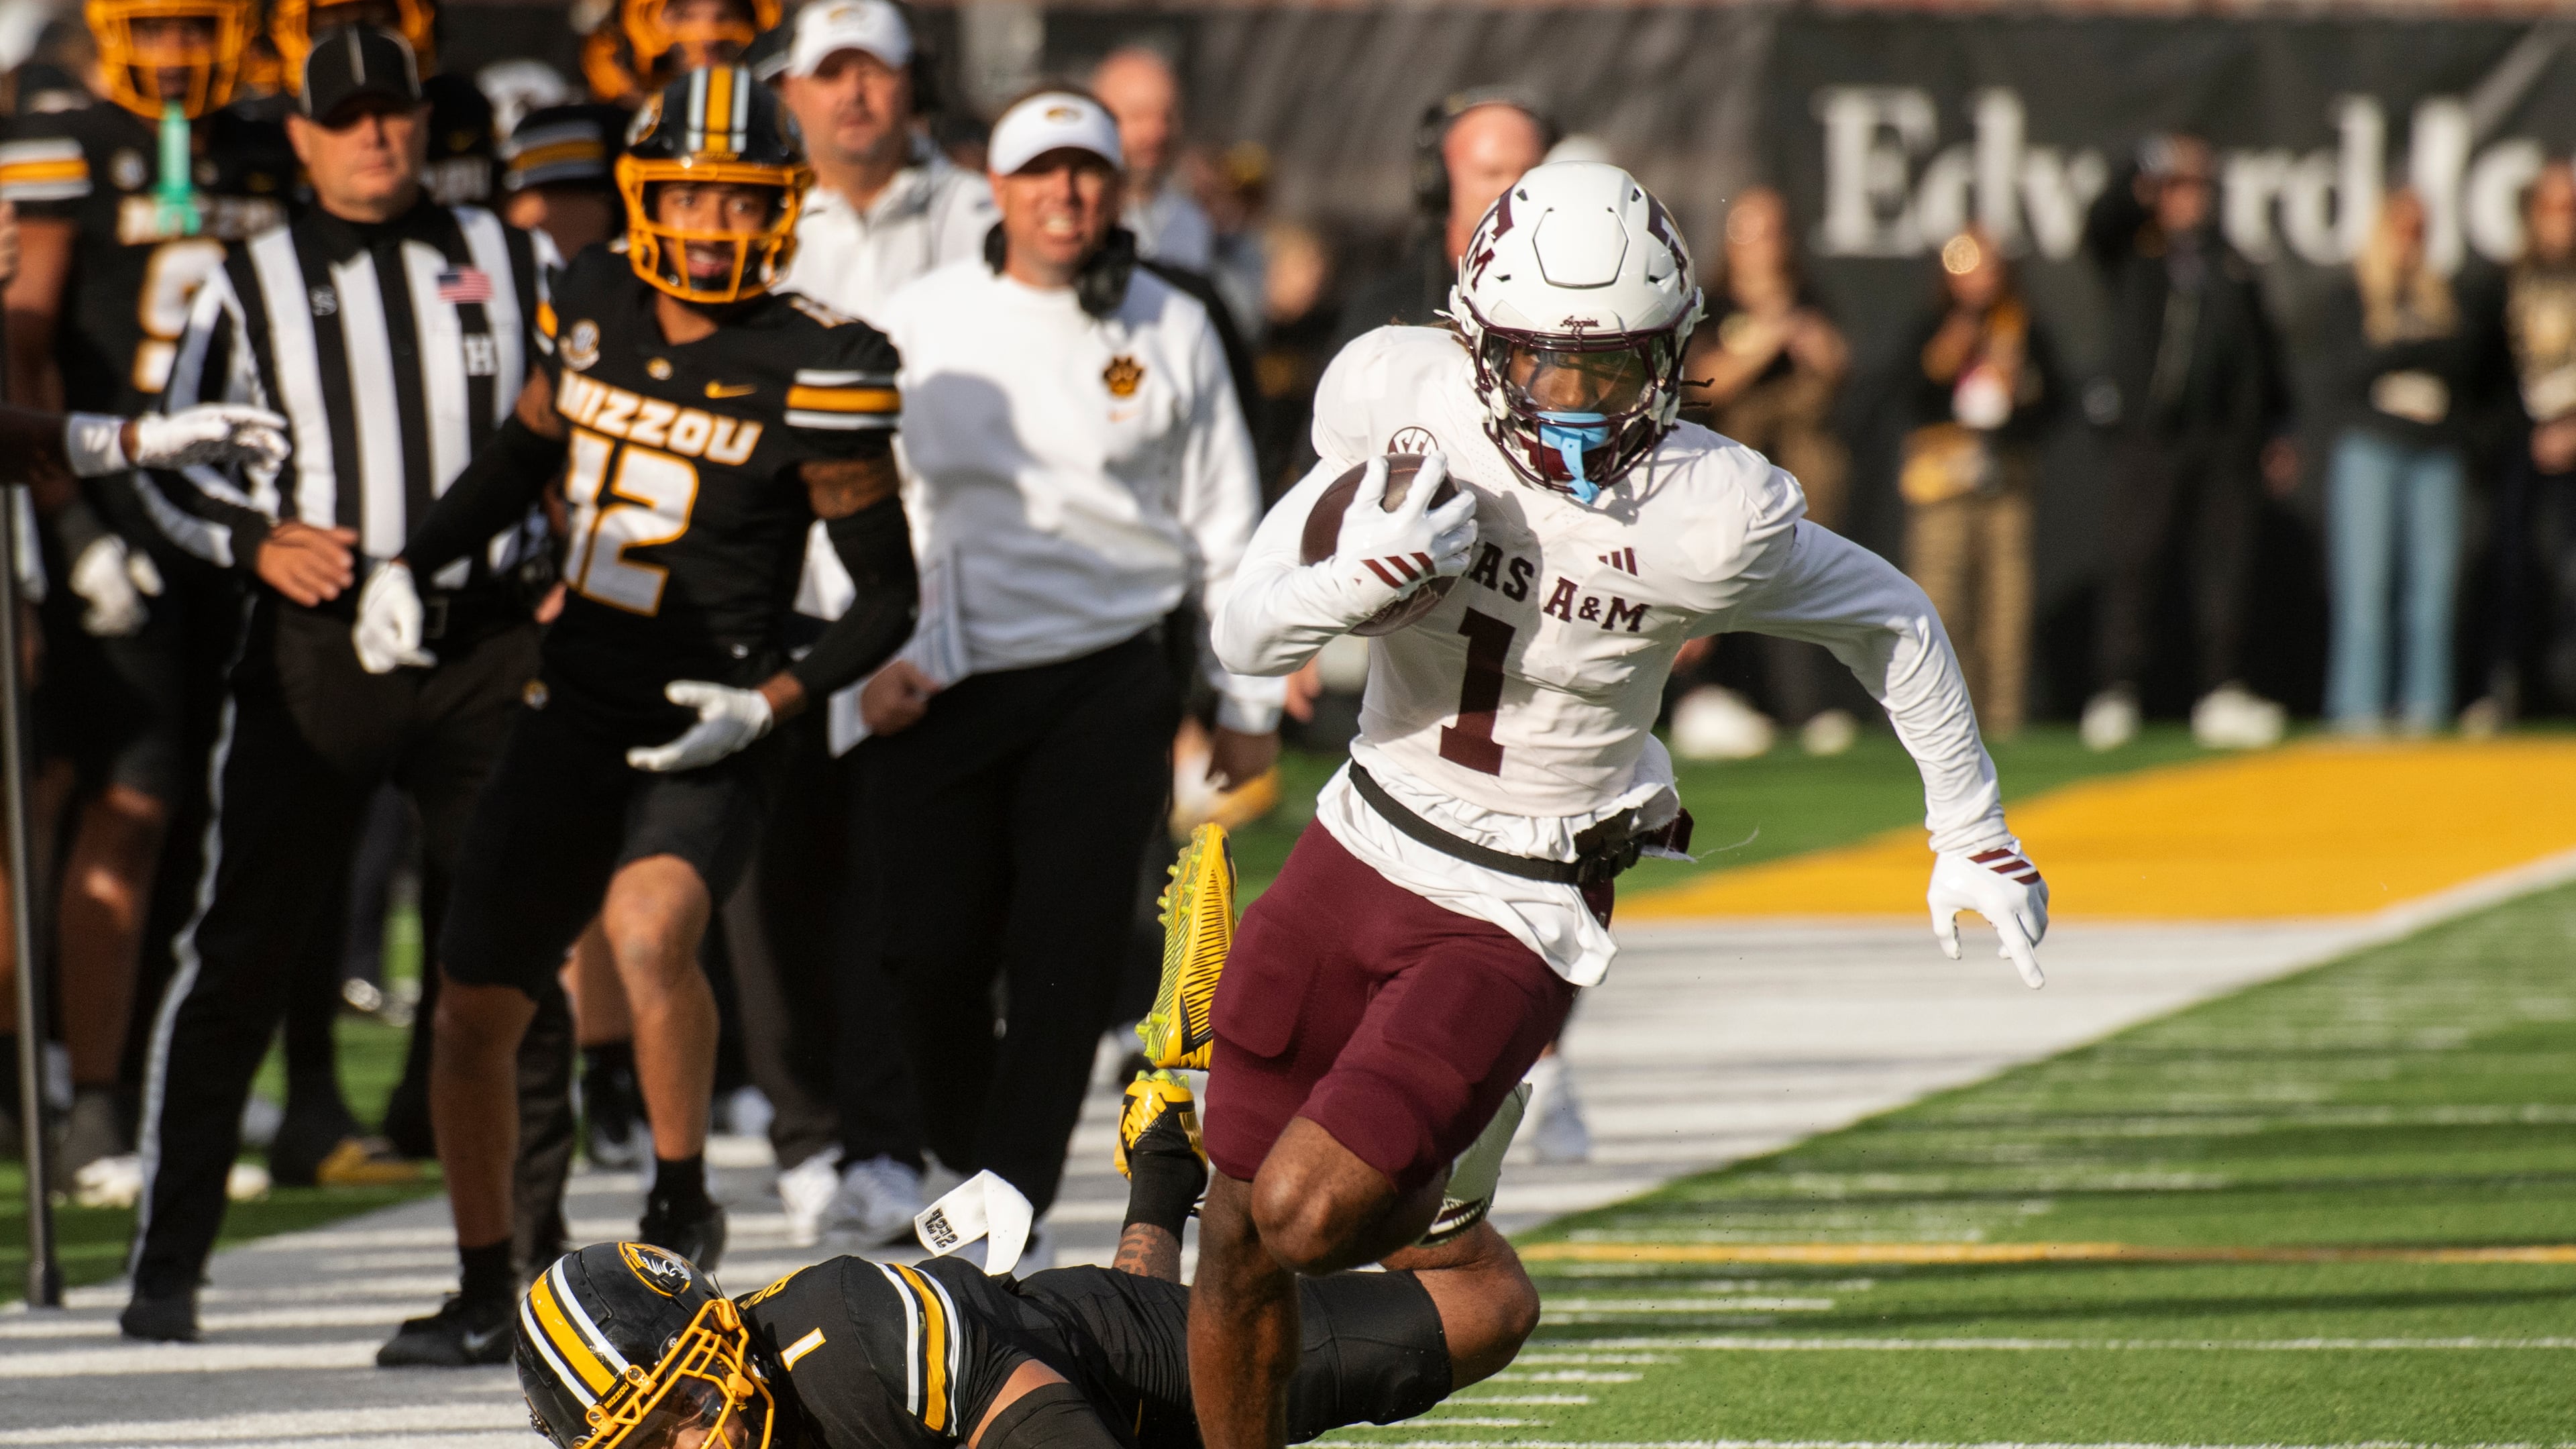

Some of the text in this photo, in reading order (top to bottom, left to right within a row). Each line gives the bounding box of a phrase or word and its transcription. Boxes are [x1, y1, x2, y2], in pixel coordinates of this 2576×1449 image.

[1809, 84, 2387, 265] Edrd
[461, 334, 498, 375] H
[564, 425, 700, 617] 12
[1462, 540, 1652, 633] AS A&M
[1439, 606, 1516, 777] 1
[604, 1382, 630, 1409] MIZZOU
